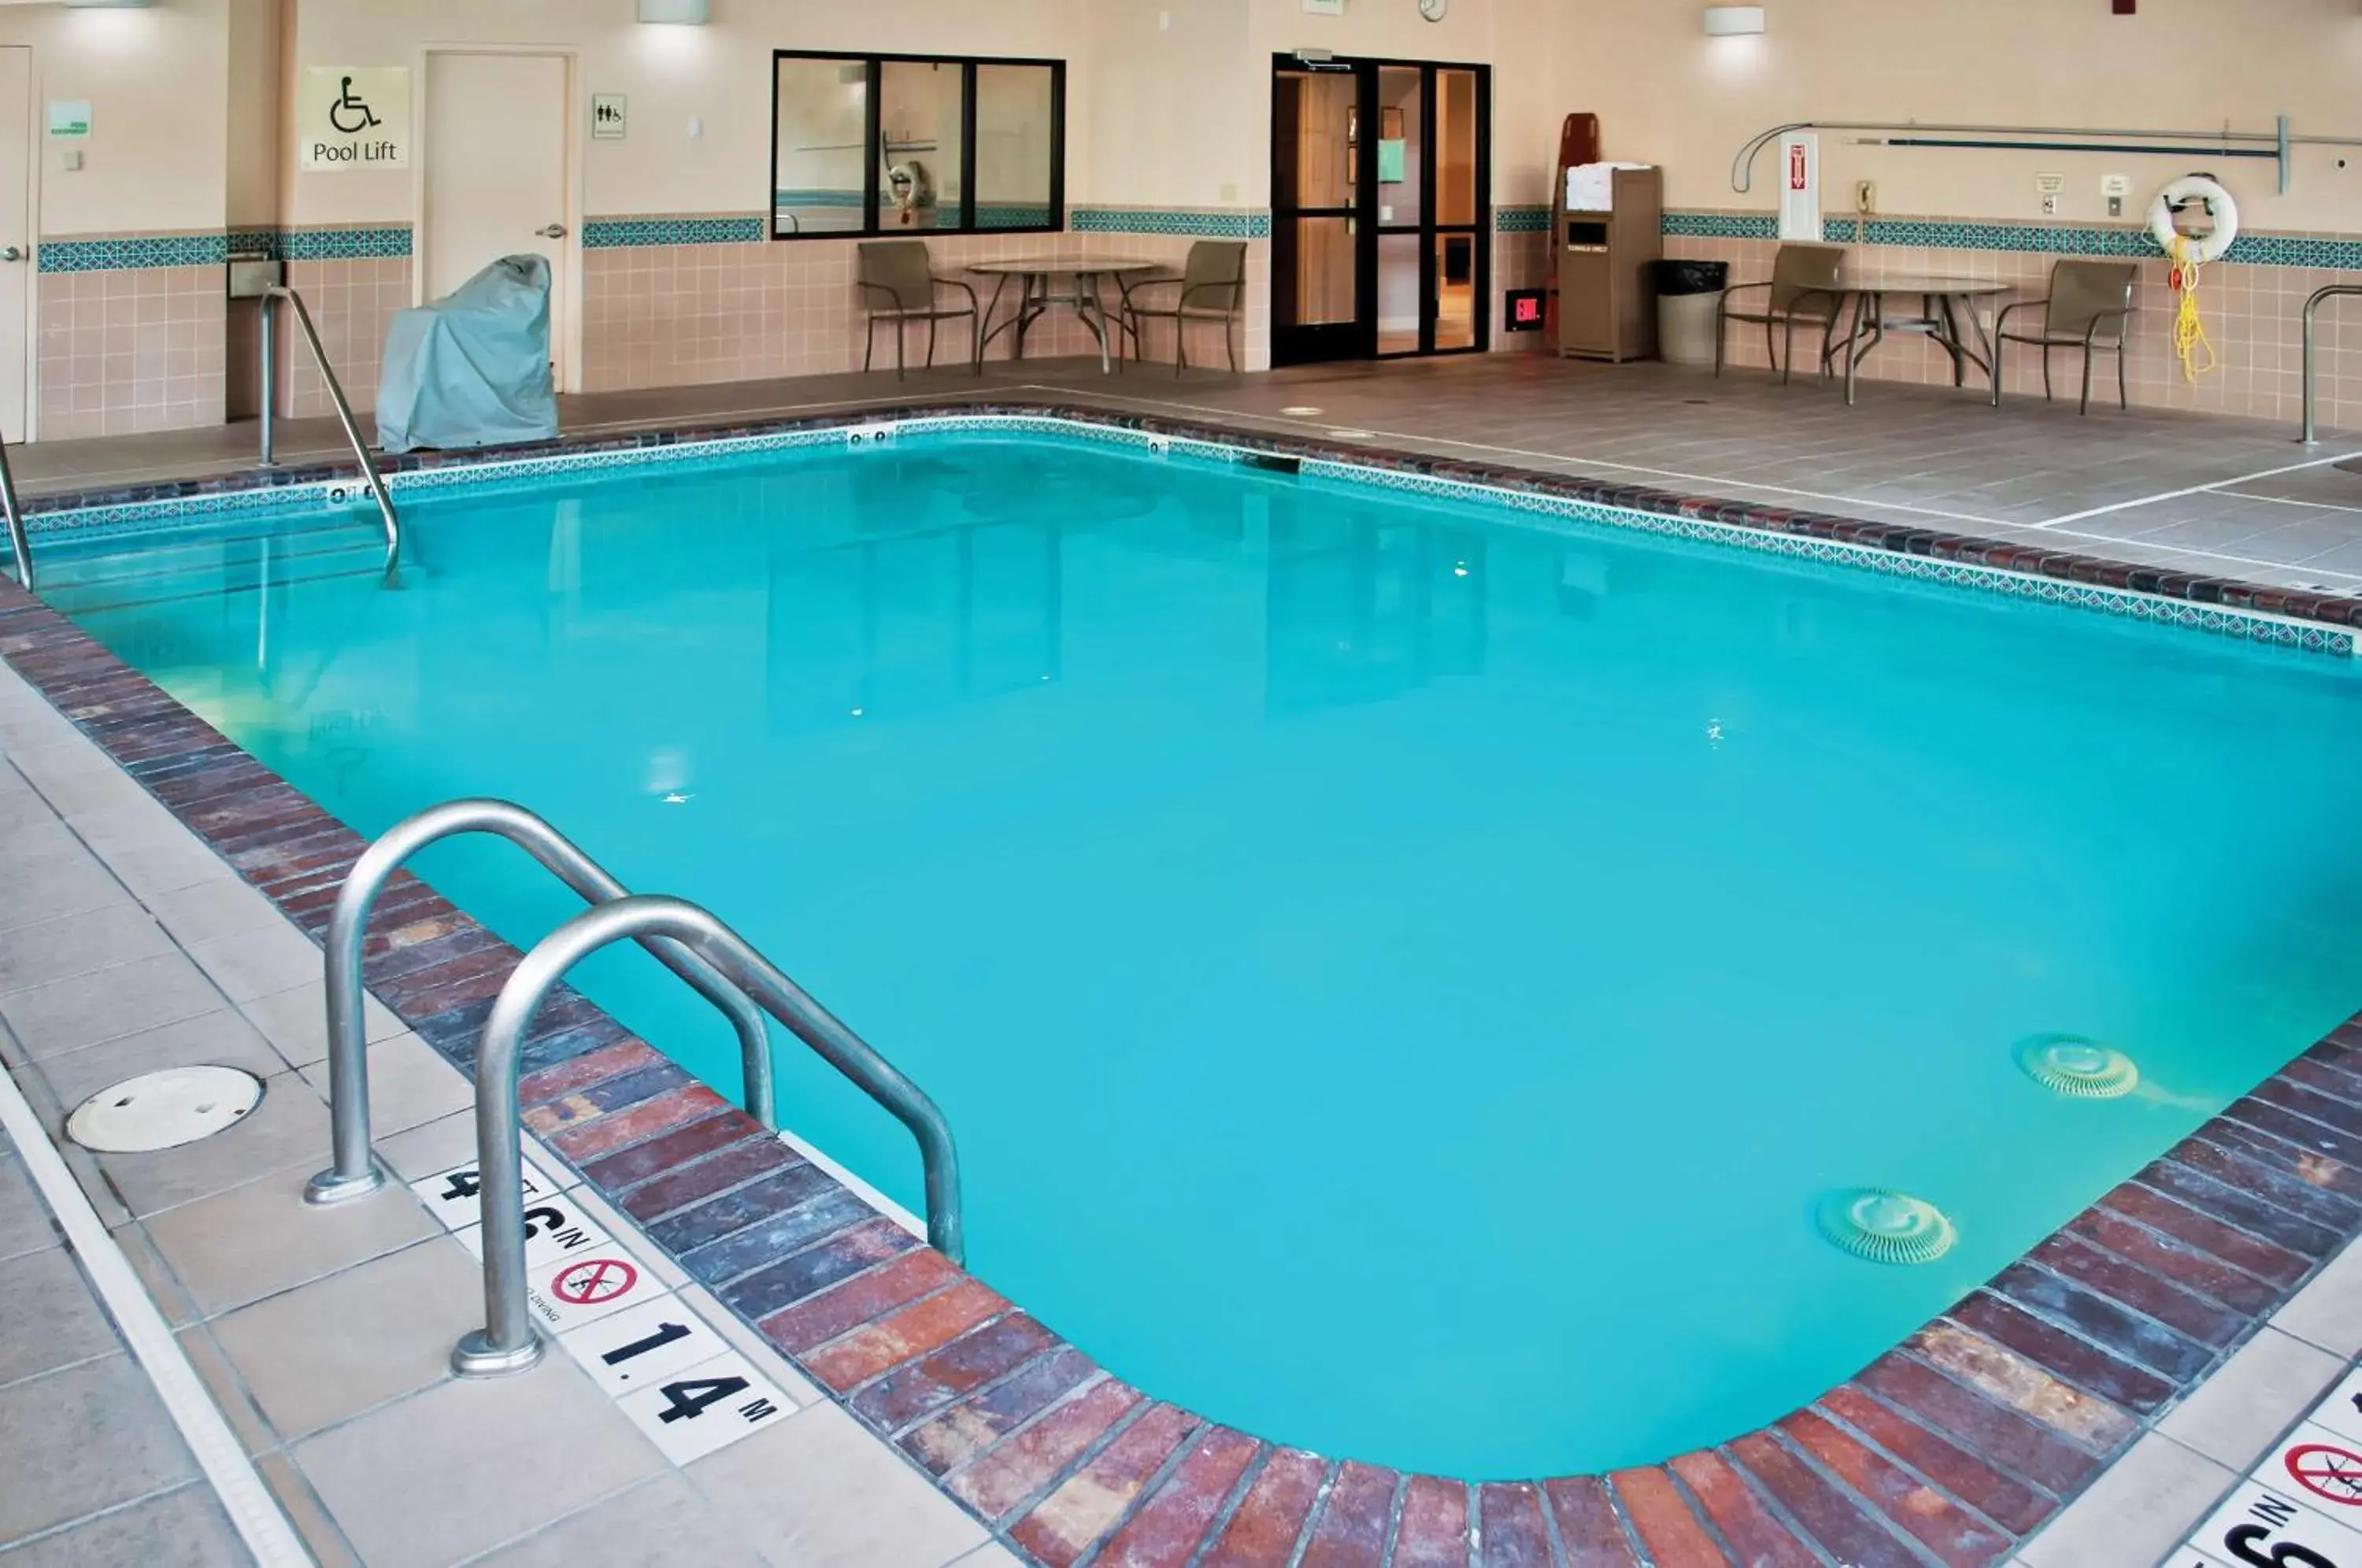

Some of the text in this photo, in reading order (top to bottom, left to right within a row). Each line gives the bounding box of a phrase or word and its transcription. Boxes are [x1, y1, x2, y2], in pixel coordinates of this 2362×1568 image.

[314, 141, 396, 161] Pool Lift
[552, 1227, 590, 1249] IN
[738, 1397, 778, 1422] M
[2248, 1493, 2298, 1528] IN
